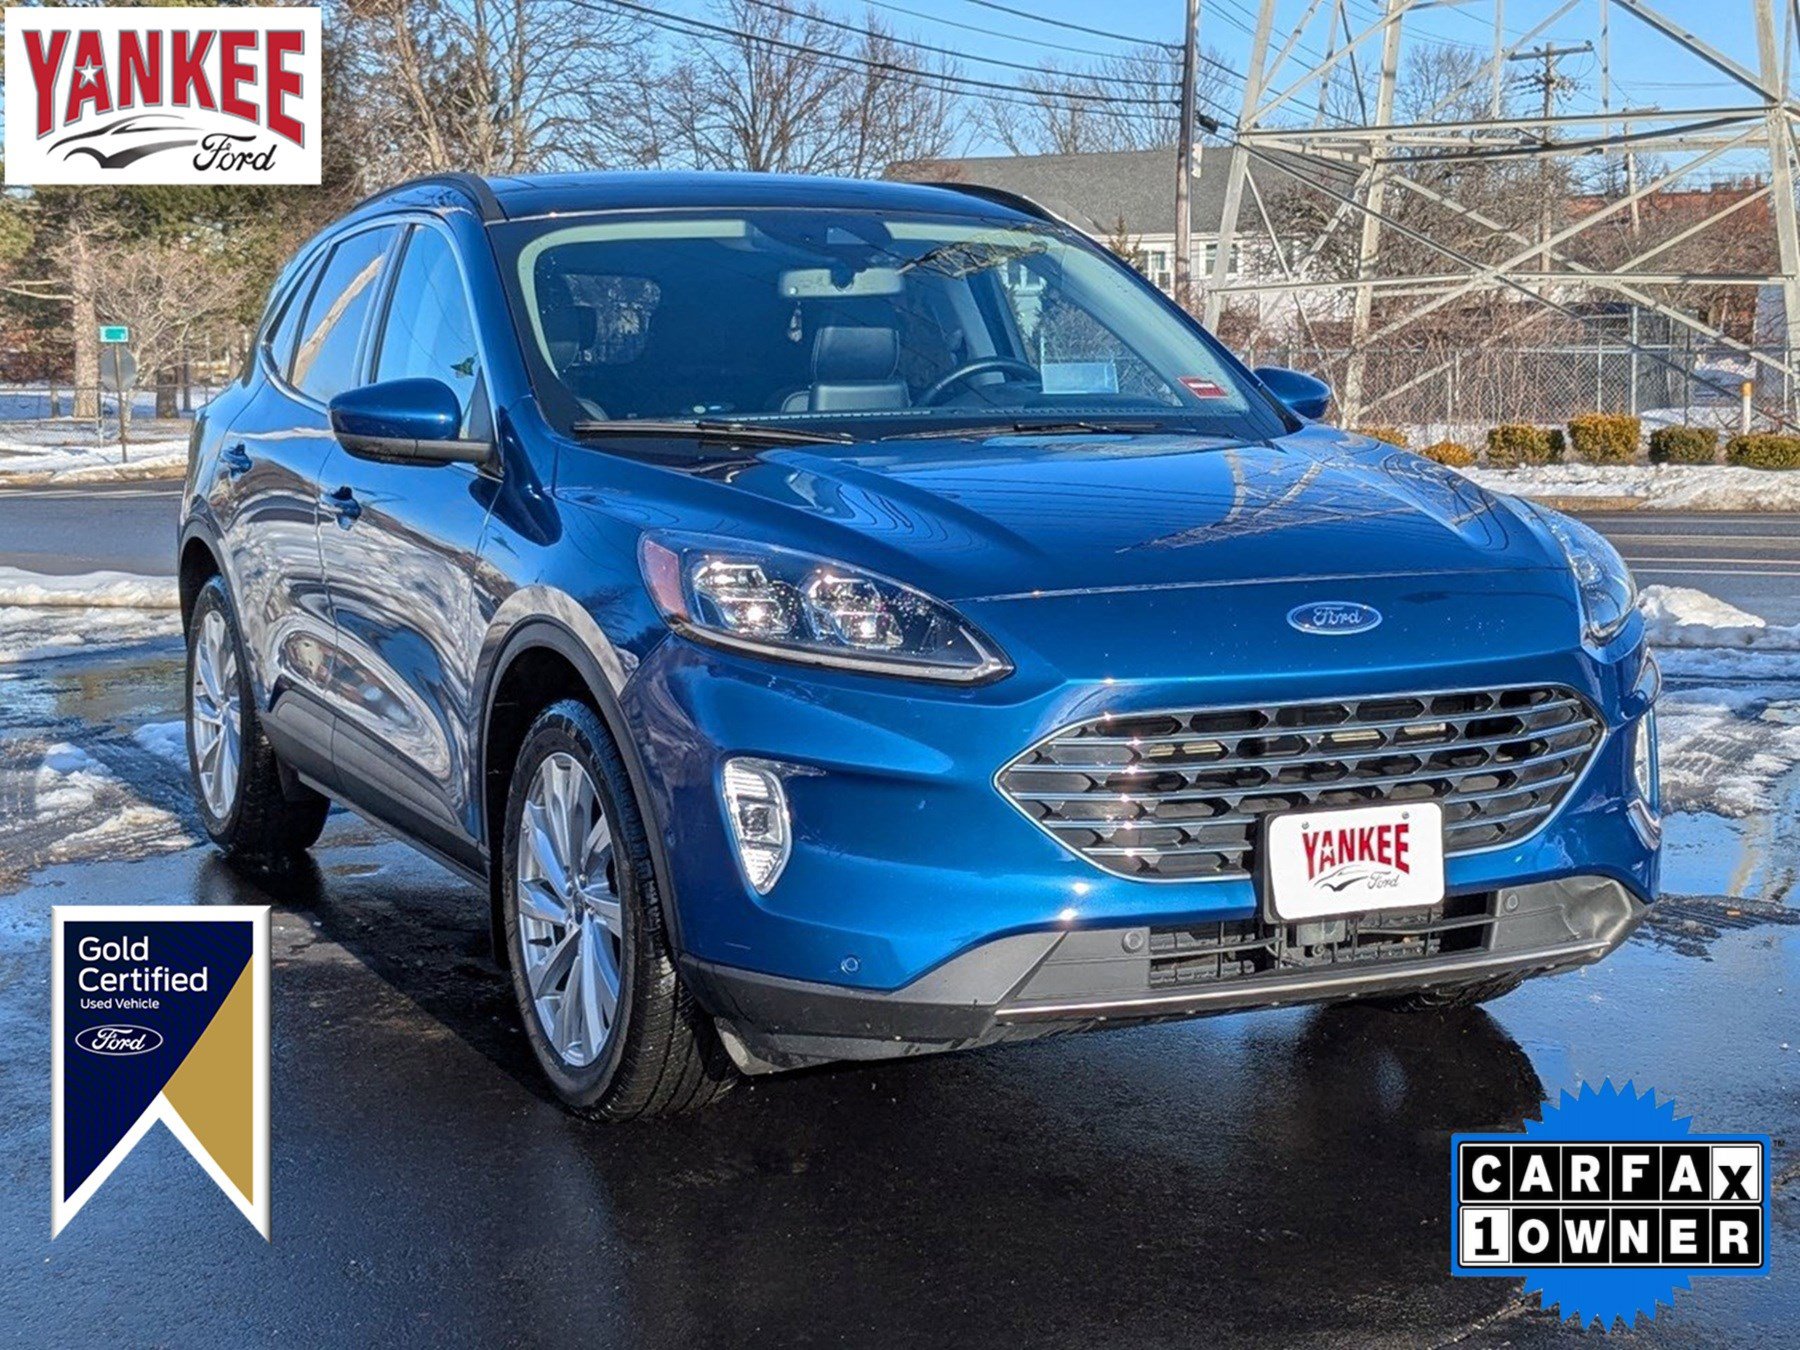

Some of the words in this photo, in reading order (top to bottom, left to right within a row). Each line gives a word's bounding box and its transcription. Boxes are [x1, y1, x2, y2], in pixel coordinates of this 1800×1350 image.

[1313, 606, 1362, 626] Ford
[1302, 823, 1410, 881] YANKEE
[1367, 871, 1400, 890] Ford
